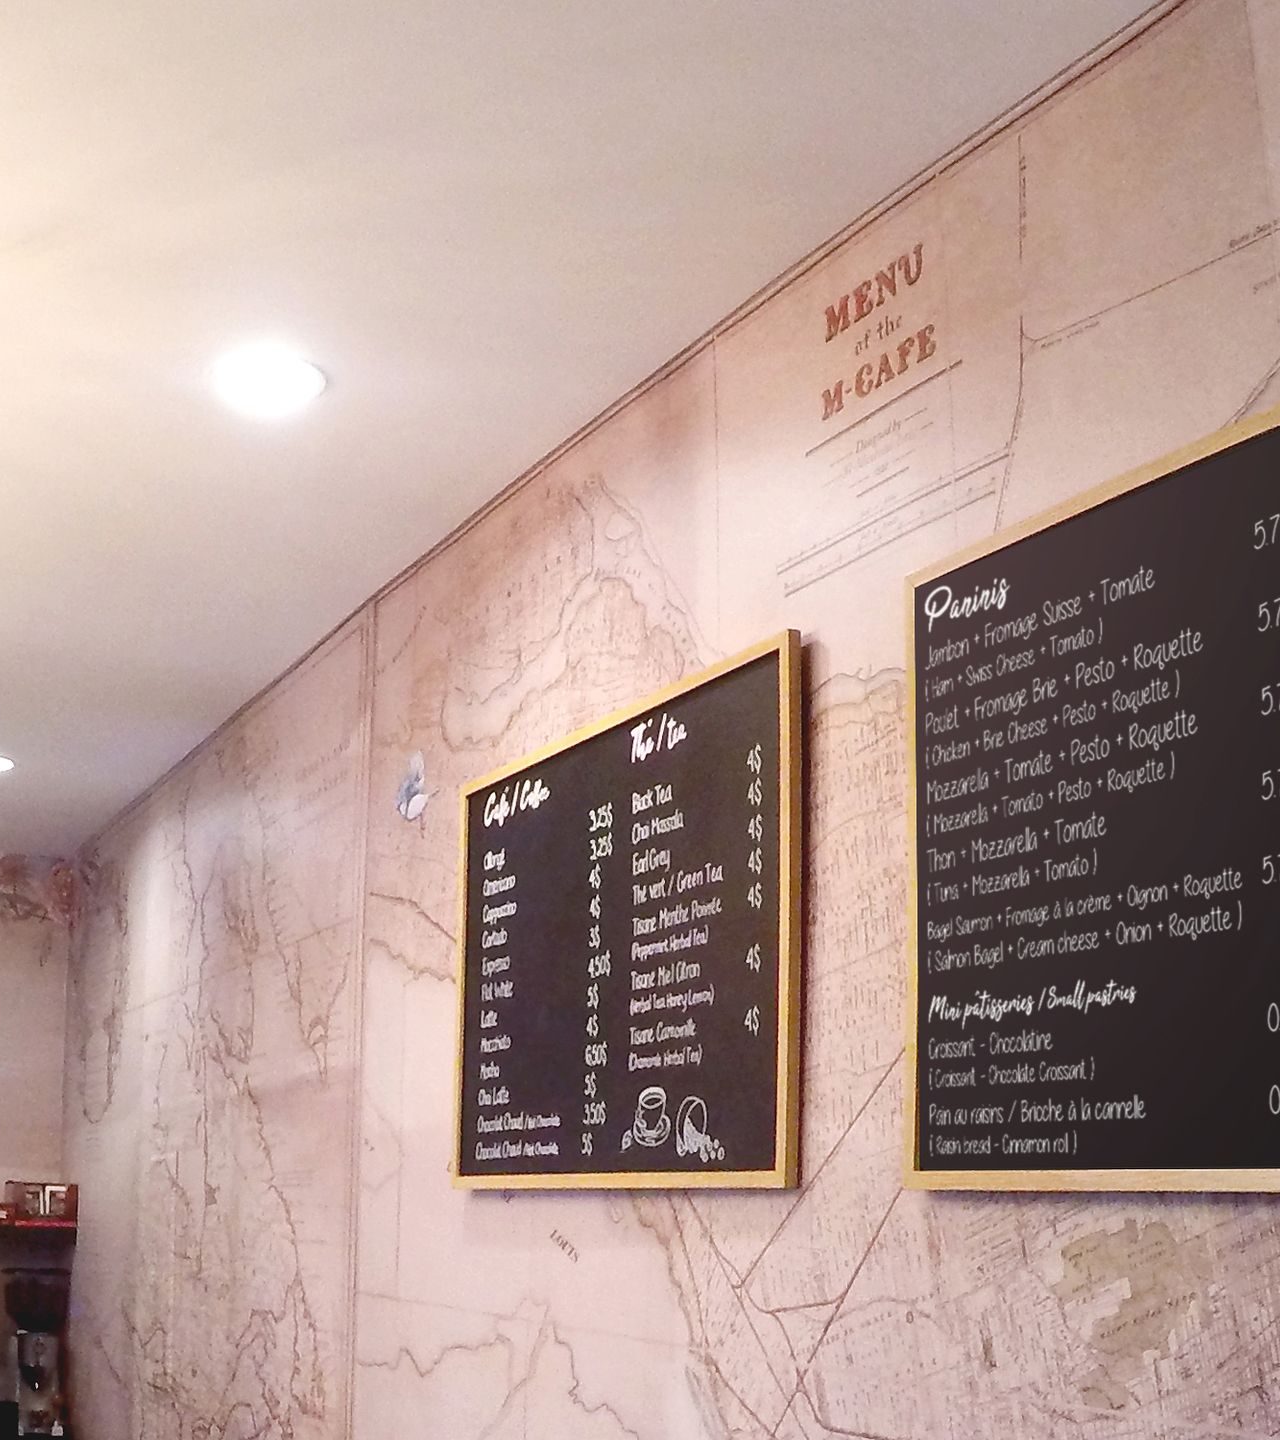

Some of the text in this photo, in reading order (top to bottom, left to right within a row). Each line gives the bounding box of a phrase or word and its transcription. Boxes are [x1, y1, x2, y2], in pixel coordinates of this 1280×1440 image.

[824, 241, 924, 344] MENU
[876, 313, 903, 341] the
[821, 323, 937, 421] M-CAFE
[924, 577, 1011, 633] Paninis
[925, 565, 1156, 671] Jambon Fromage Suisse Tomate
[1049, 626, 1095, 657] Tomato
[974, 688, 1028, 719] Fromage
[1032, 677, 1059, 704] Brie
[1075, 656, 1115, 689] Pesto
[1133, 627, 1204, 671] Roquette
[983, 729, 1005, 752] Brie
[1062, 699, 1097, 727] Pesto
[1112, 677, 1171, 714] Roquette
[746, 743, 762, 774] 4$
[926, 709, 1199, 805] Mozzarella Tomate Pesto Roquette
[654, 784, 673, 806] Tea
[747, 777, 762, 806] 4$
[933, 759, 1166, 835] Mozzarella Tomato Pesto Roquette
[747, 813, 763, 842] 4$
[971, 826, 1038, 864] Mozzarella
[1053, 811, 1107, 845] Tomate
[747, 847, 762, 875] 4$
[971, 865, 1030, 897] Mozzarella
[1043, 854, 1090, 882] Tomato
[676, 870, 704, 894] Green
[704, 862, 724, 883] Tea
[747, 882, 763, 909] 4$
[1005, 905, 1050, 928] Fromage
[1126, 884, 1169, 911] Oignon
[1183, 867, 1243, 900] Roquette
[1017, 936, 1055, 960] Cream
[1056, 931, 1100, 954] cheese
[1115, 920, 1152, 946] Onion
[1168, 905, 1233, 941] Roquette
[745, 943, 761, 973] 4$
[744, 1005, 760, 1037] 4$
[927, 994, 963, 1024] Mini
[1020, 1097, 1065, 1123] Brioche
